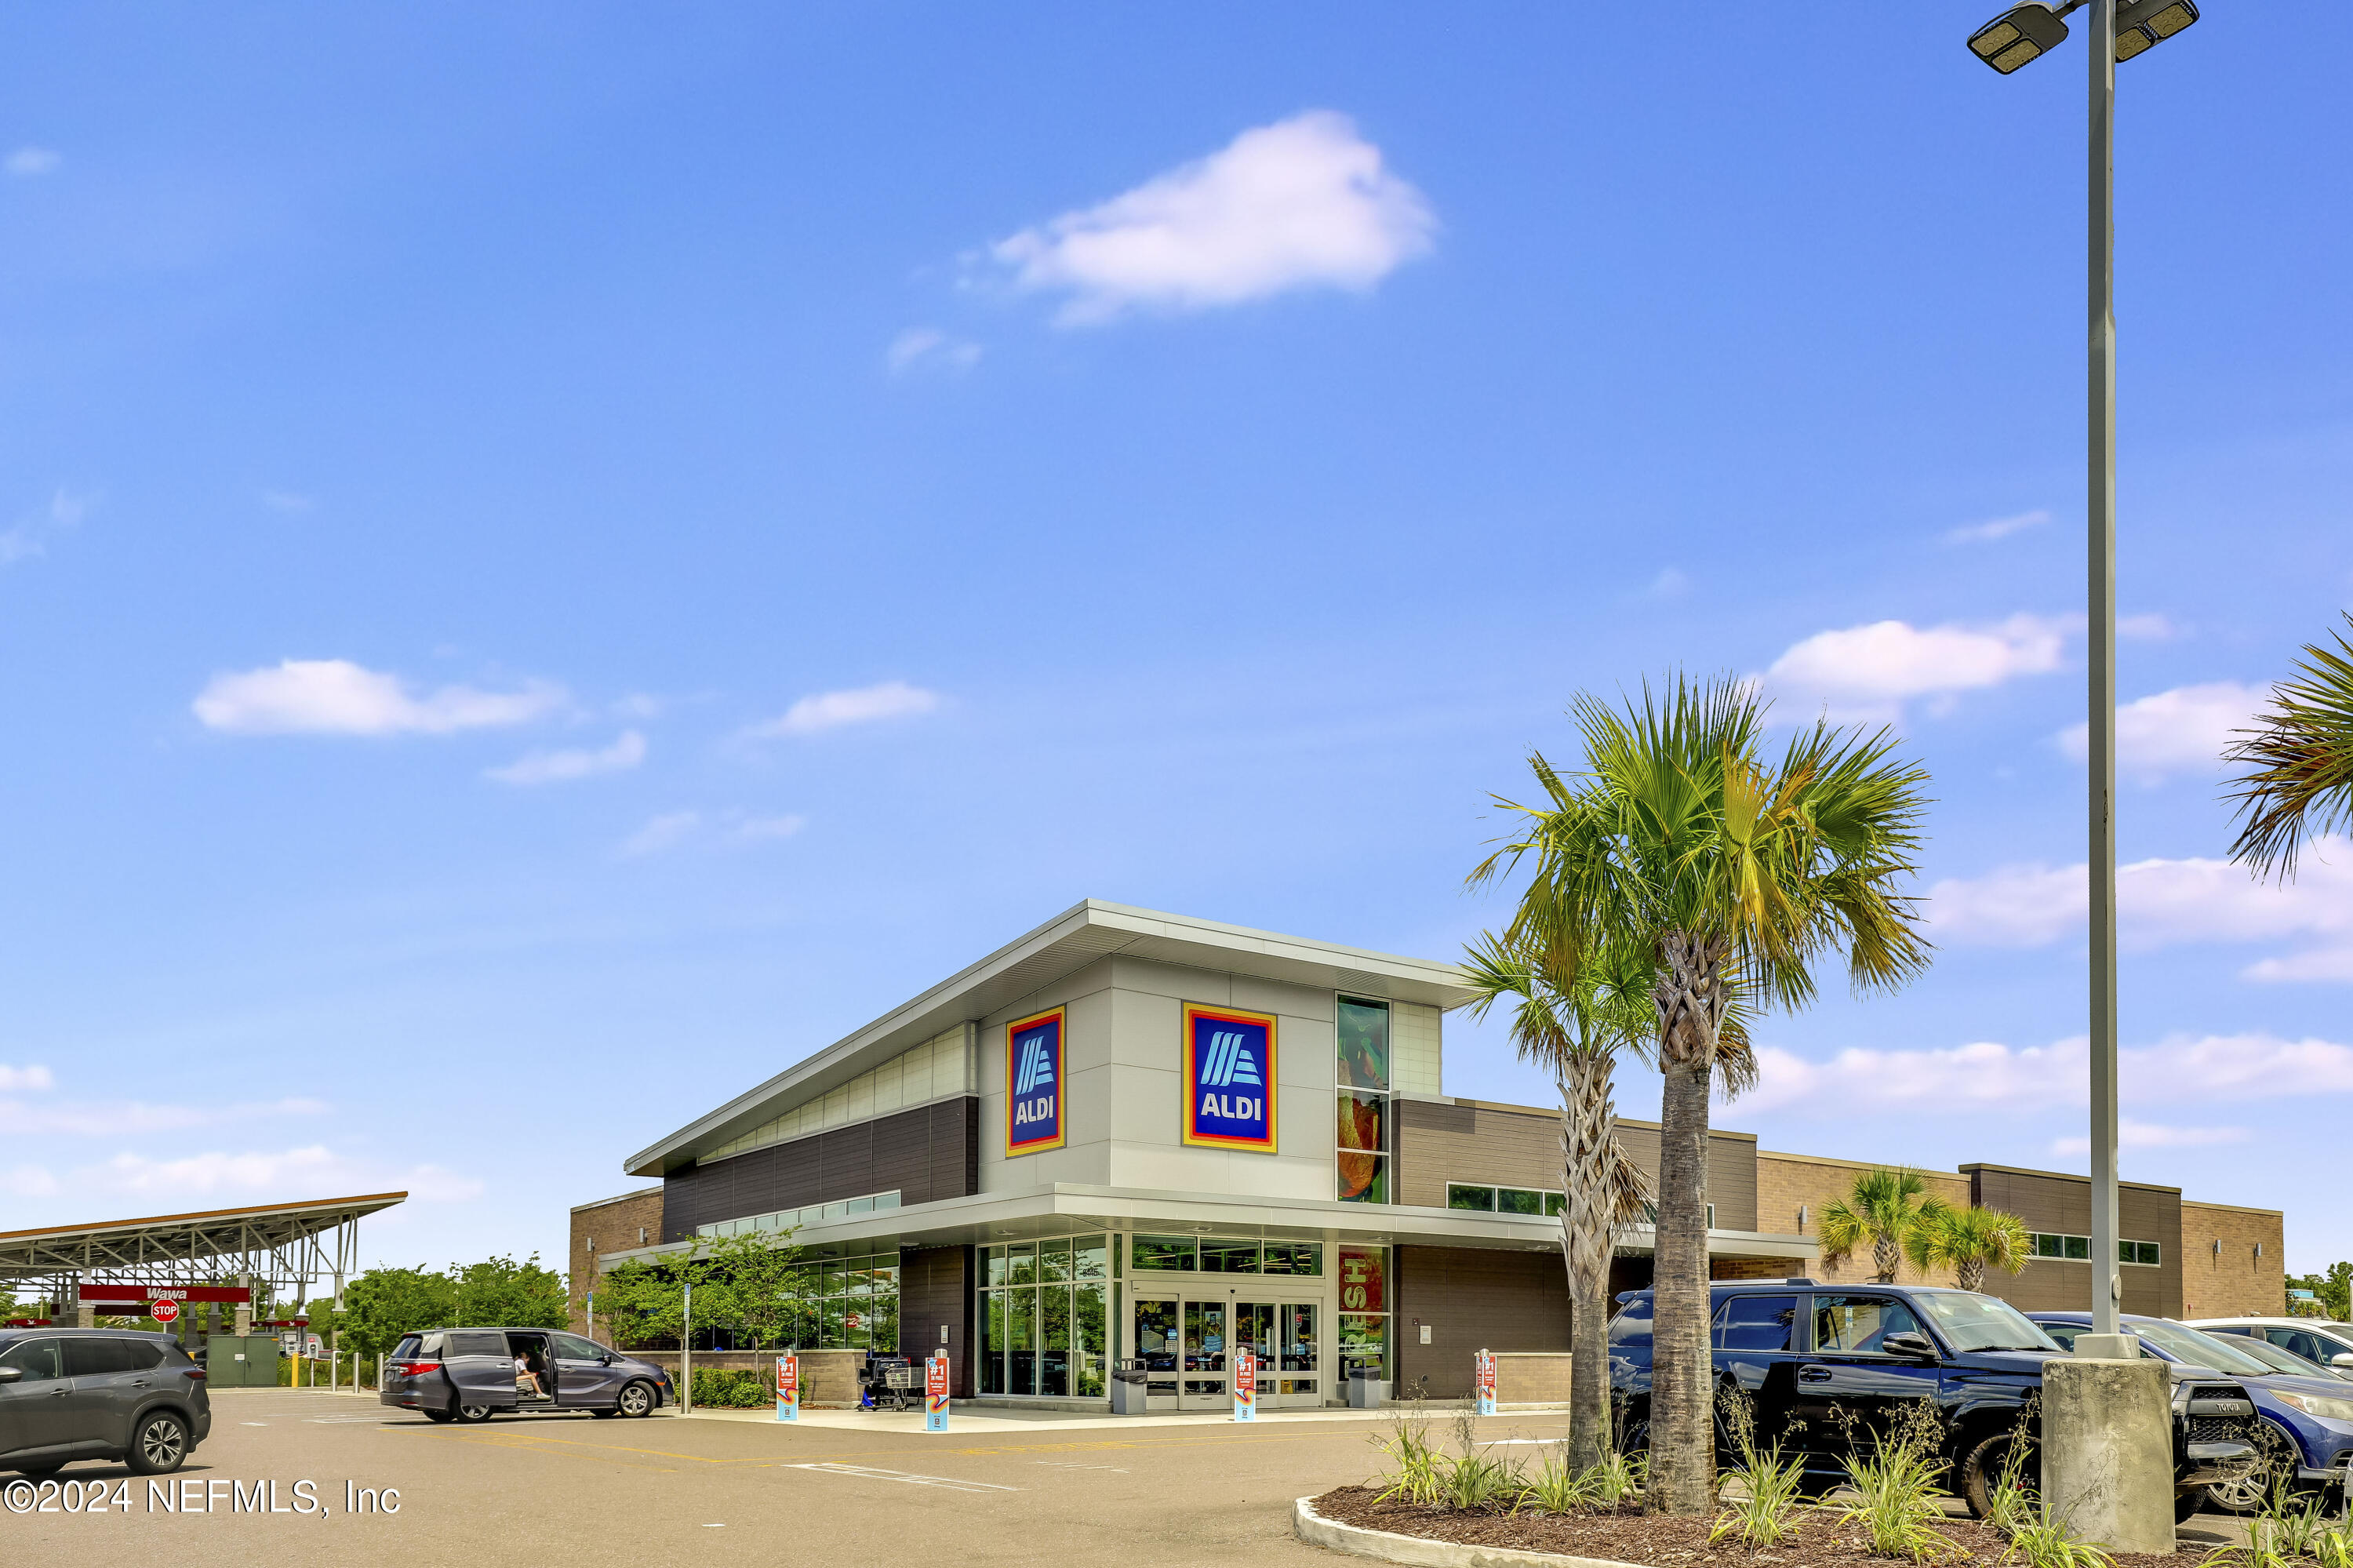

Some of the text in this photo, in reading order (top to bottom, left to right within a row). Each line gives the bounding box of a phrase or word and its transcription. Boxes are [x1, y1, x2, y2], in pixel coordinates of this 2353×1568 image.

[1016, 1096, 1053, 1125] ALDI
[1201, 1093, 1261, 1121] ALDI
[147, 1287, 187, 1299] Wawa
[154, 1306, 176, 1315] STOP
[780, 1362, 794, 1372] #1
[930, 1365, 944, 1375] #1
[1238, 1362, 1251, 1372] #1
[1486, 1362, 1494, 1370] #1
[2217, 1402, 2241, 1412] TOYOTA
